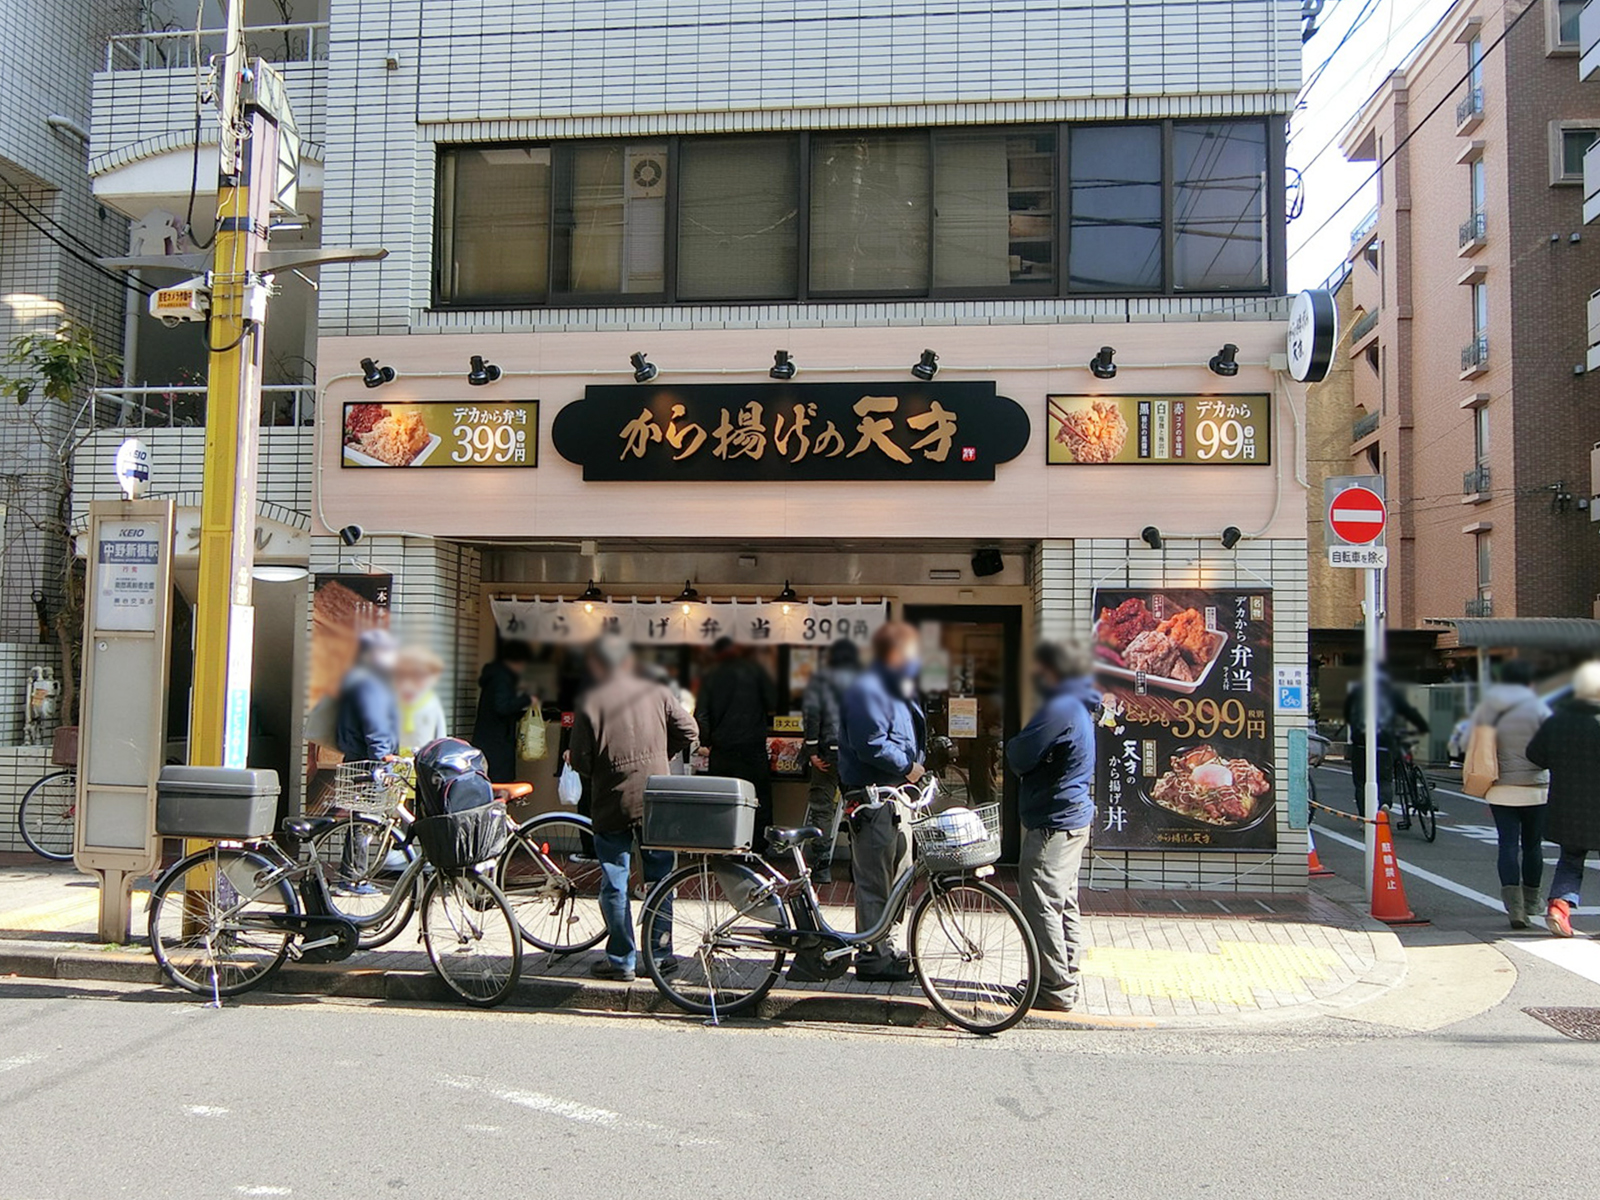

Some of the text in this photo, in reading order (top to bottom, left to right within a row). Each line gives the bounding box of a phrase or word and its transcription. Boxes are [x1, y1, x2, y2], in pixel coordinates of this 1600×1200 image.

[453, 407, 527, 425] デカから弁当
[1196, 400, 1252, 419] デカから
[618, 396, 957, 464] から揚げの天才
[119, 529, 145, 538] KEIO
[104, 543, 159, 558] 中野新橋駅
[1332, 551, 1384, 564] 自転車を除く
[1230, 596, 1253, 692] デカから弁当
[775, 719, 801, 729] 注文口
[1125, 703, 1171, 728] どちらも
[1122, 740, 1141, 785] 天才の
[1103, 756, 1128, 832] から揚げ丼
